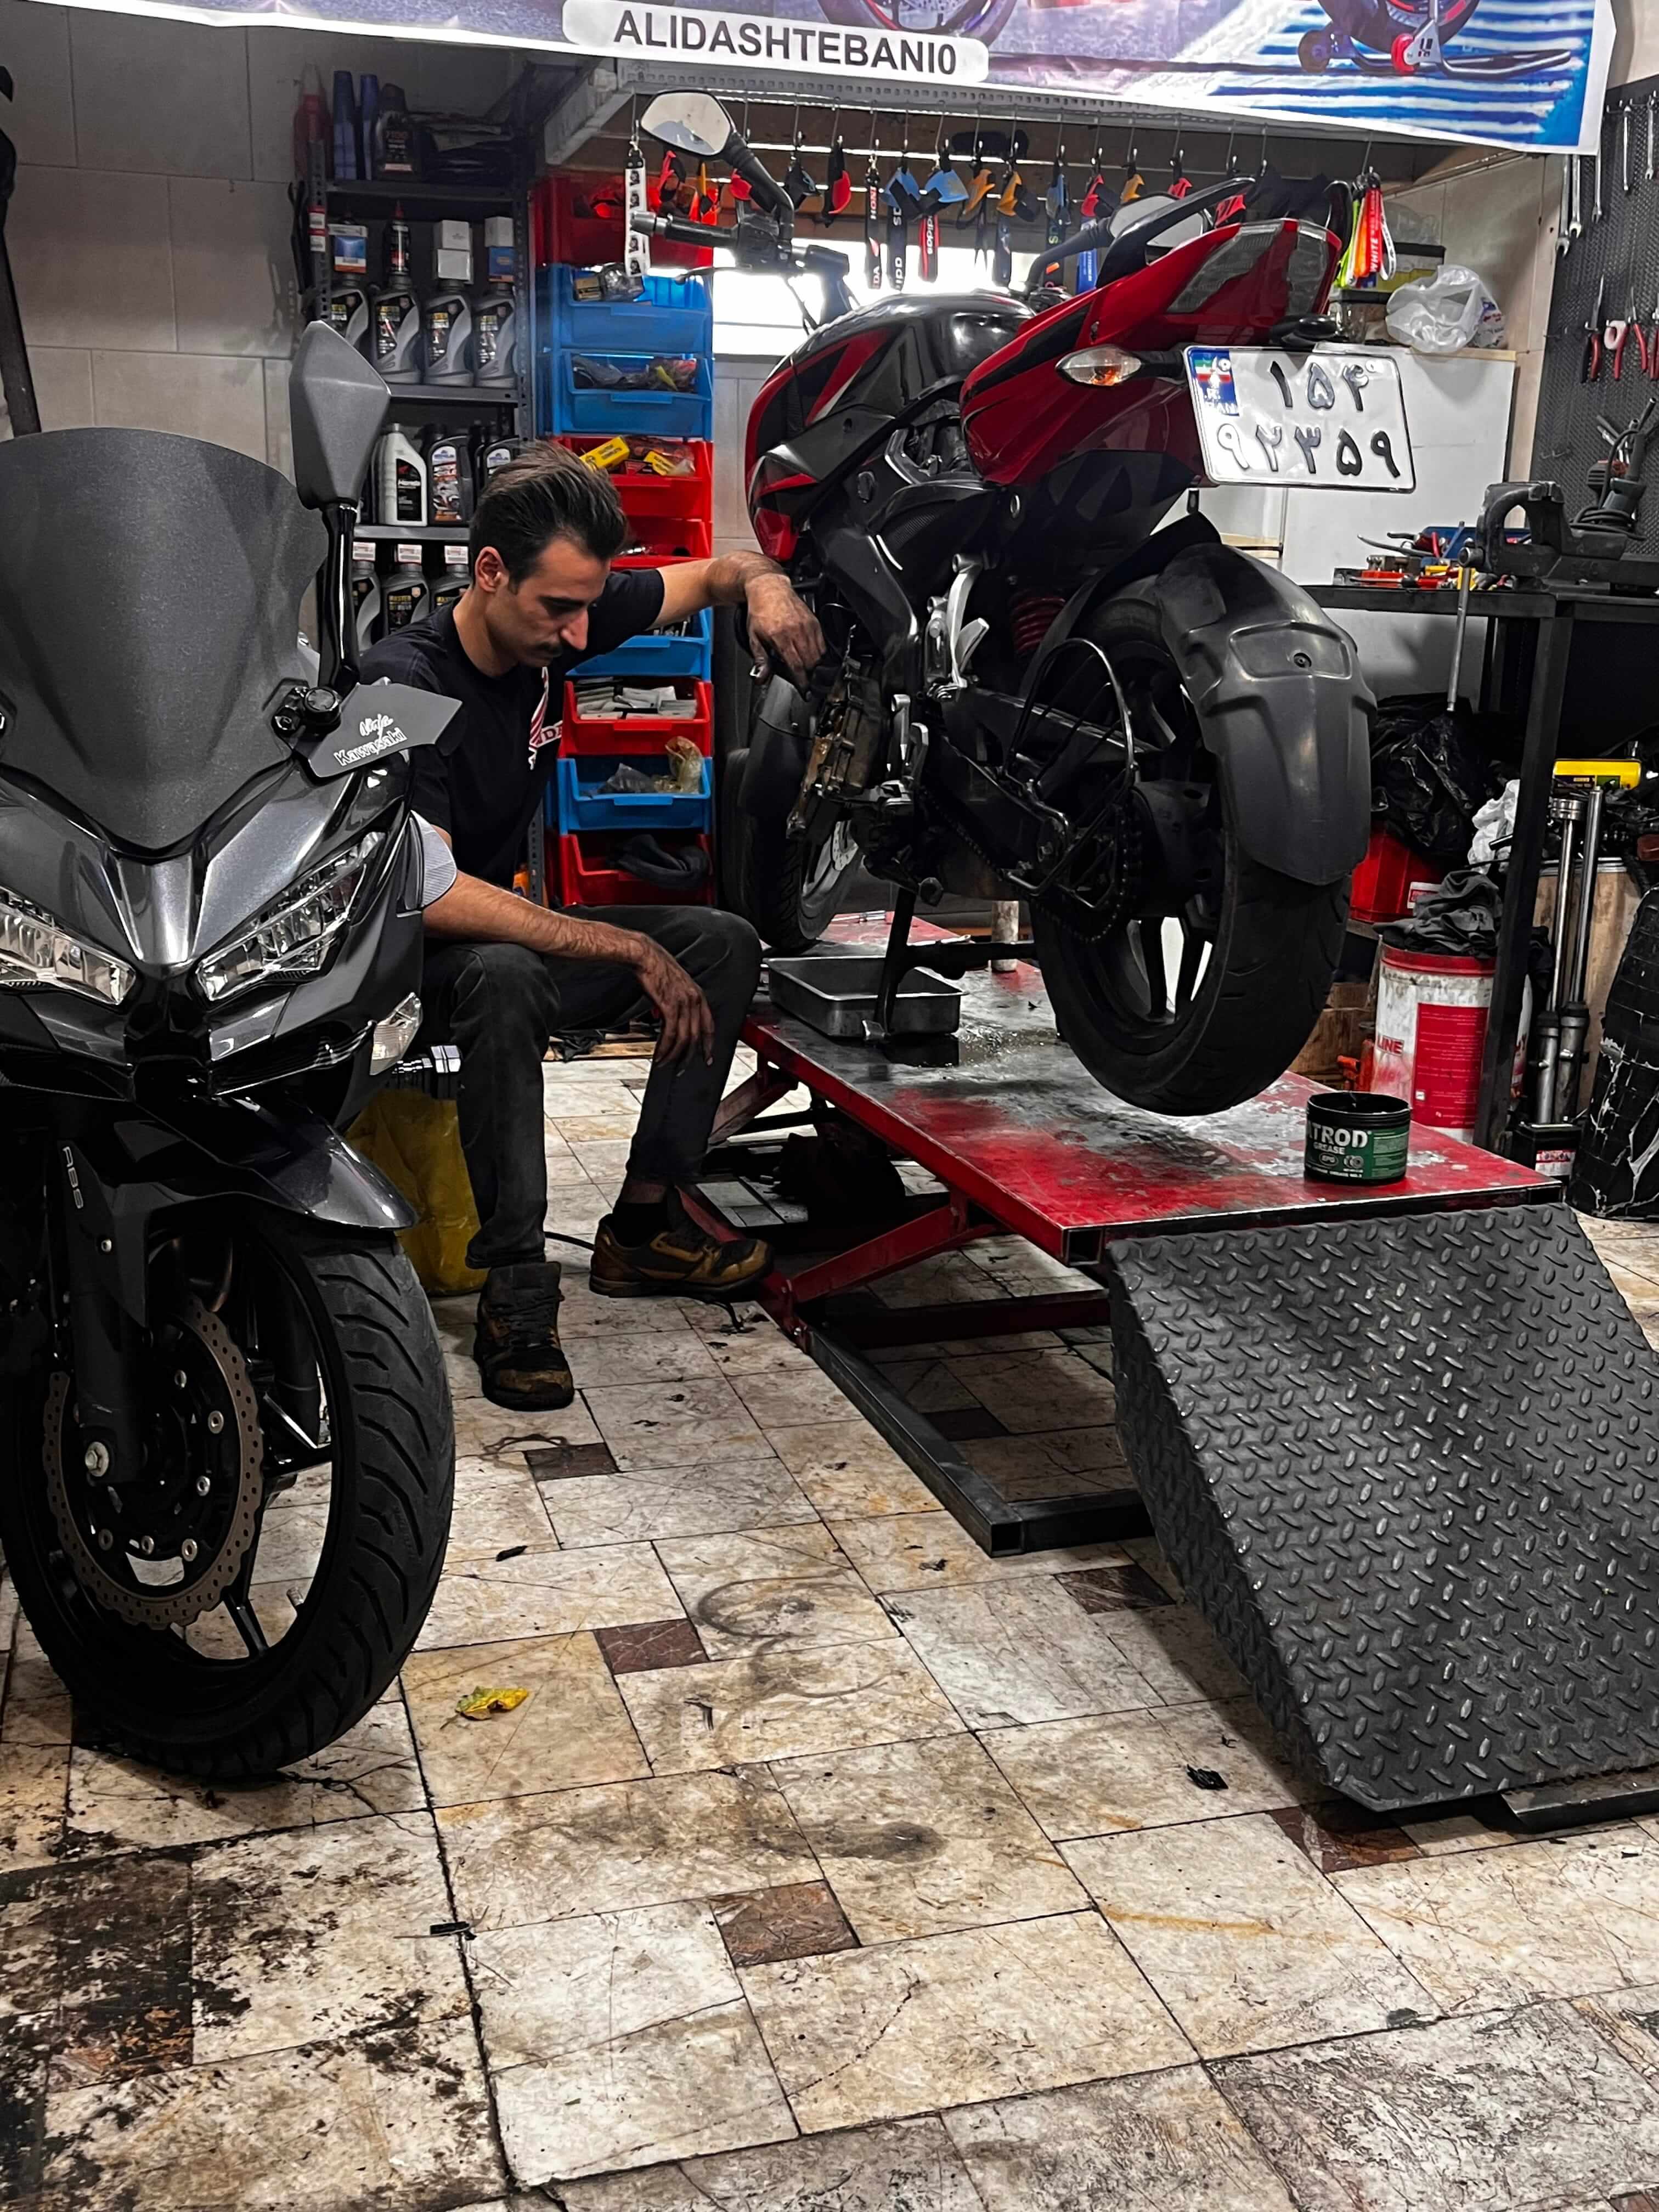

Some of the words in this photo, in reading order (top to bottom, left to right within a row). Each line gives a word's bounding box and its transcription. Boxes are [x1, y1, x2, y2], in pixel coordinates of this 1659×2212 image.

[1369, 237, 1378, 273] WHITE
[1270, 360, 1369, 412] ۱۵۴
[1217, 423, 1401, 478] ۹۲۳۵۹
[333, 727, 408, 766] Kawasaki
[62, 1146, 84, 1209] ABS
